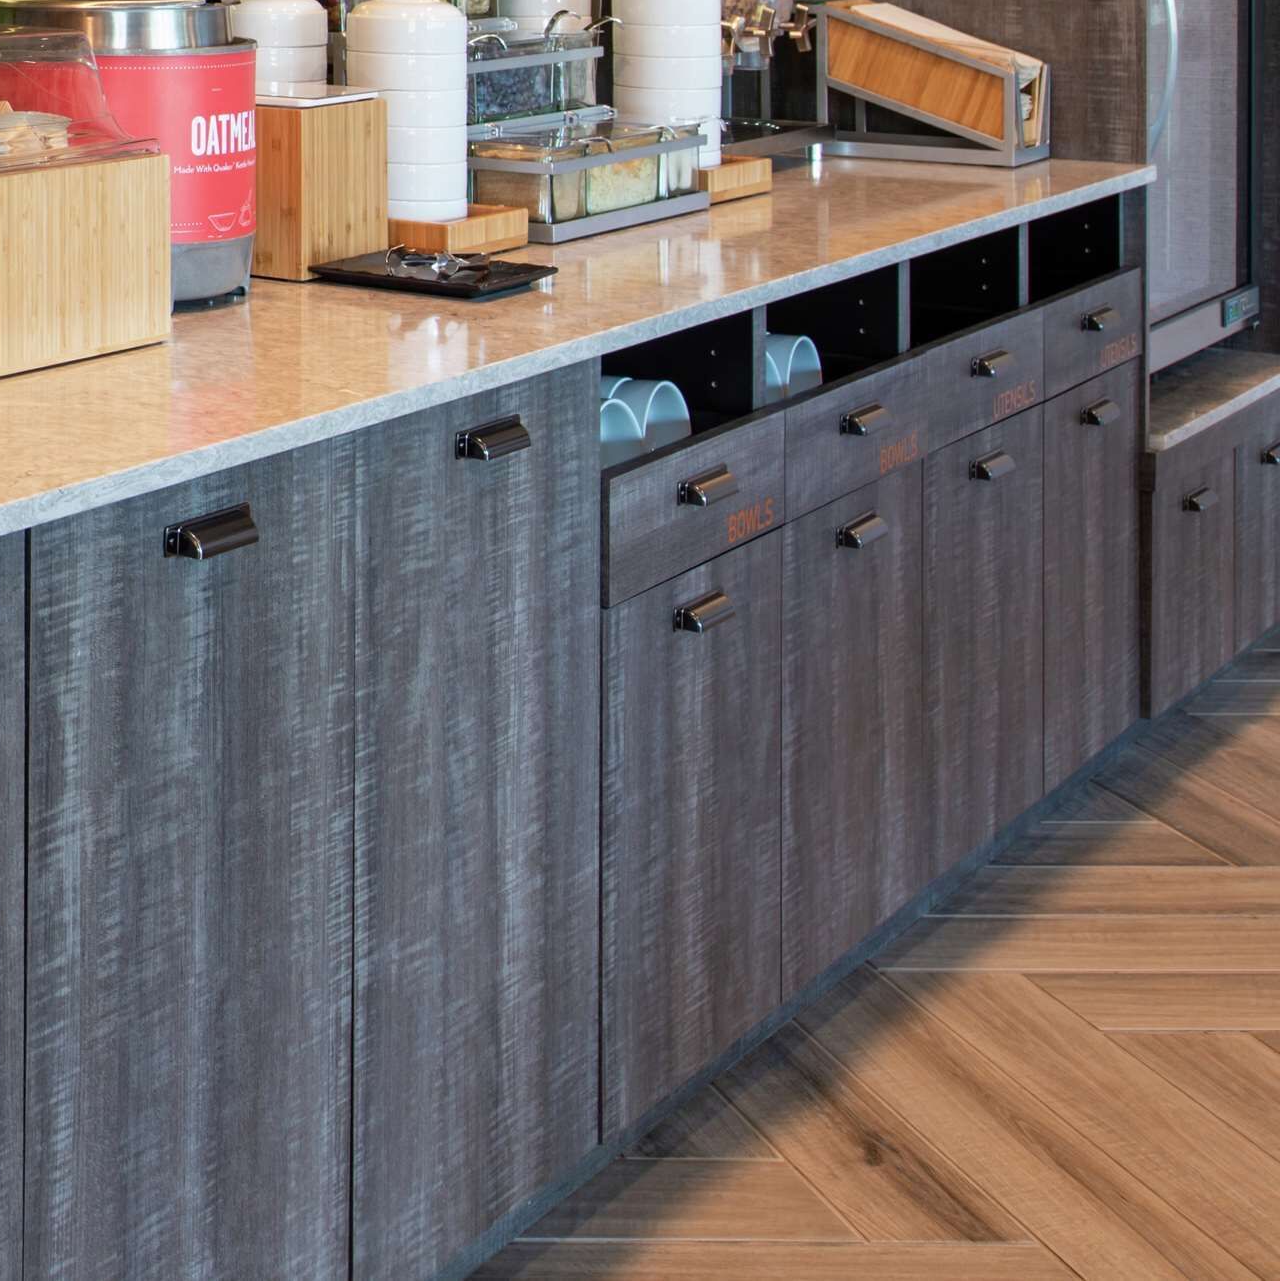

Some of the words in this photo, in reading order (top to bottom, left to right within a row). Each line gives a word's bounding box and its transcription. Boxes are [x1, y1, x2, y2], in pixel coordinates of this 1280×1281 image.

[173, 165, 194, 174] Made
[196, 164, 212, 173] With
[1099, 333, 1138, 367] UTENSILS
[993, 380, 1036, 420] UTENSILS
[880, 430, 919, 475] BOWLS
[727, 495, 775, 543] BOWLS
